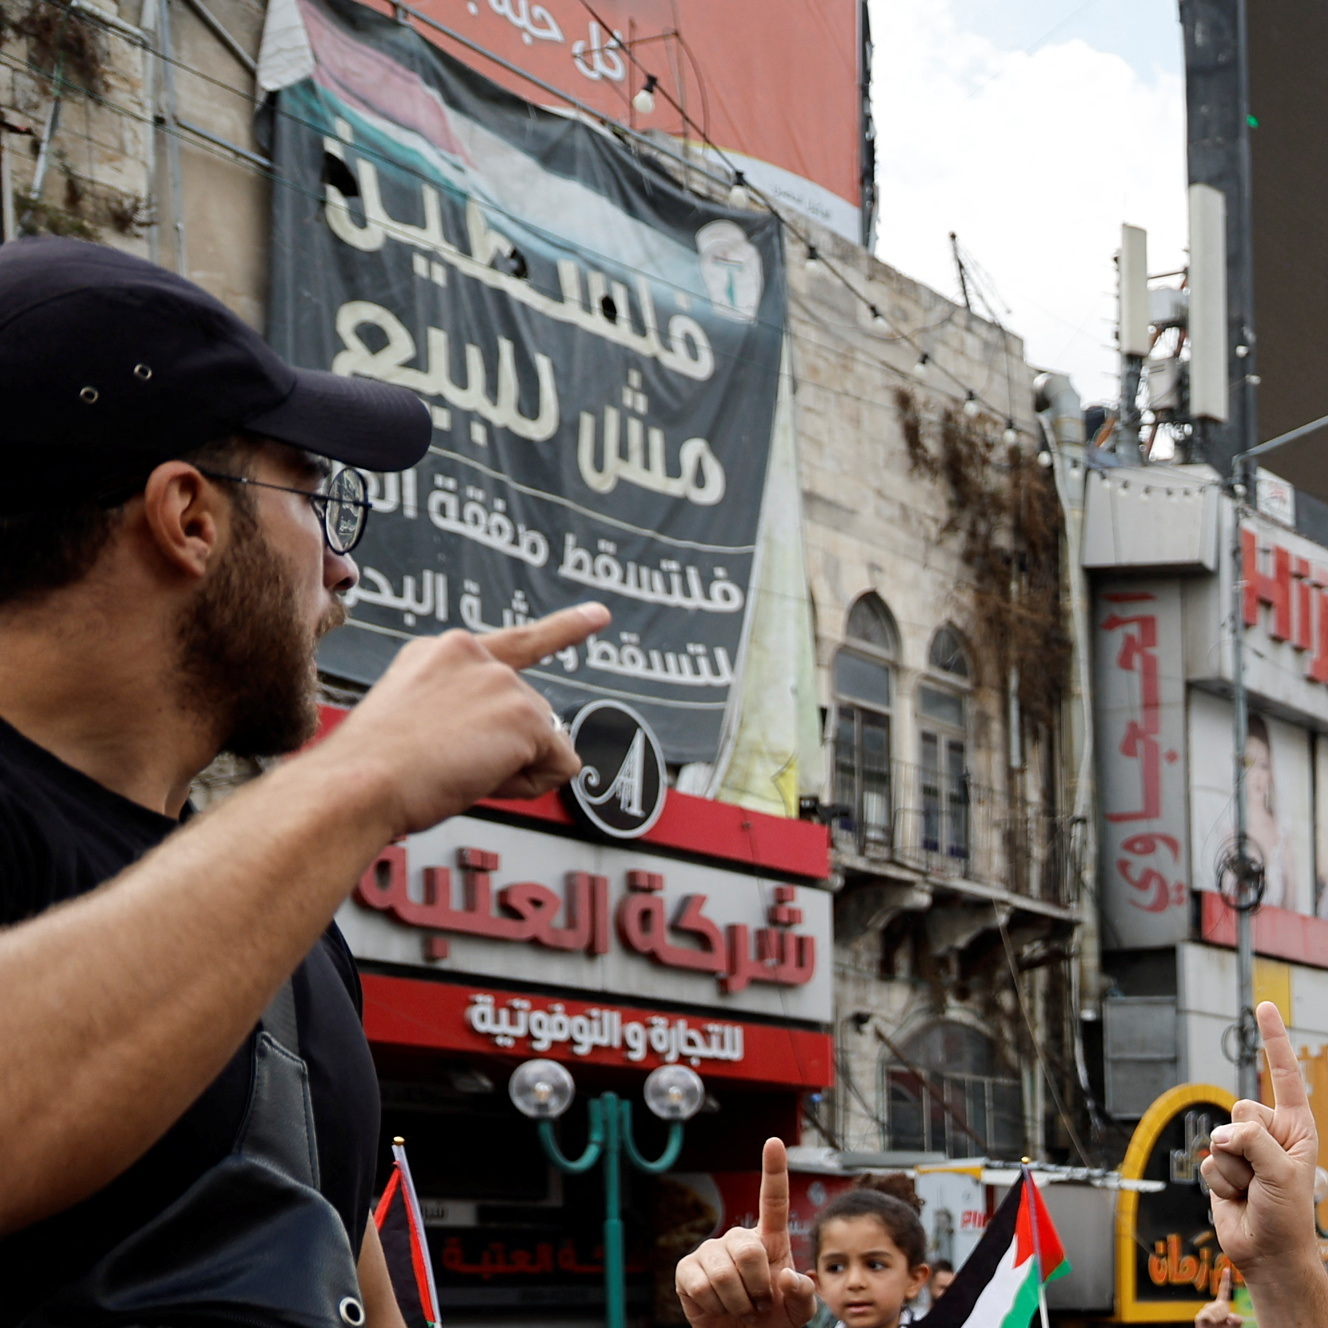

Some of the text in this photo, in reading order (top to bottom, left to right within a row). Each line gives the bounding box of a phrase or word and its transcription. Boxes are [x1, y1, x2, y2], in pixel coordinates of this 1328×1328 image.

[324, 117, 716, 382] فلسطين
[333, 301, 560, 446] للبيع
[578, 368, 726, 506] مش
[427, 474, 551, 569] صفقة
[557, 532, 745, 613] فلتسقط
[355, 833, 817, 994] شركة العتبة
[465, 993, 623, 1057] النوفوتية
[649, 1015, 745, 1066] للتجارة
